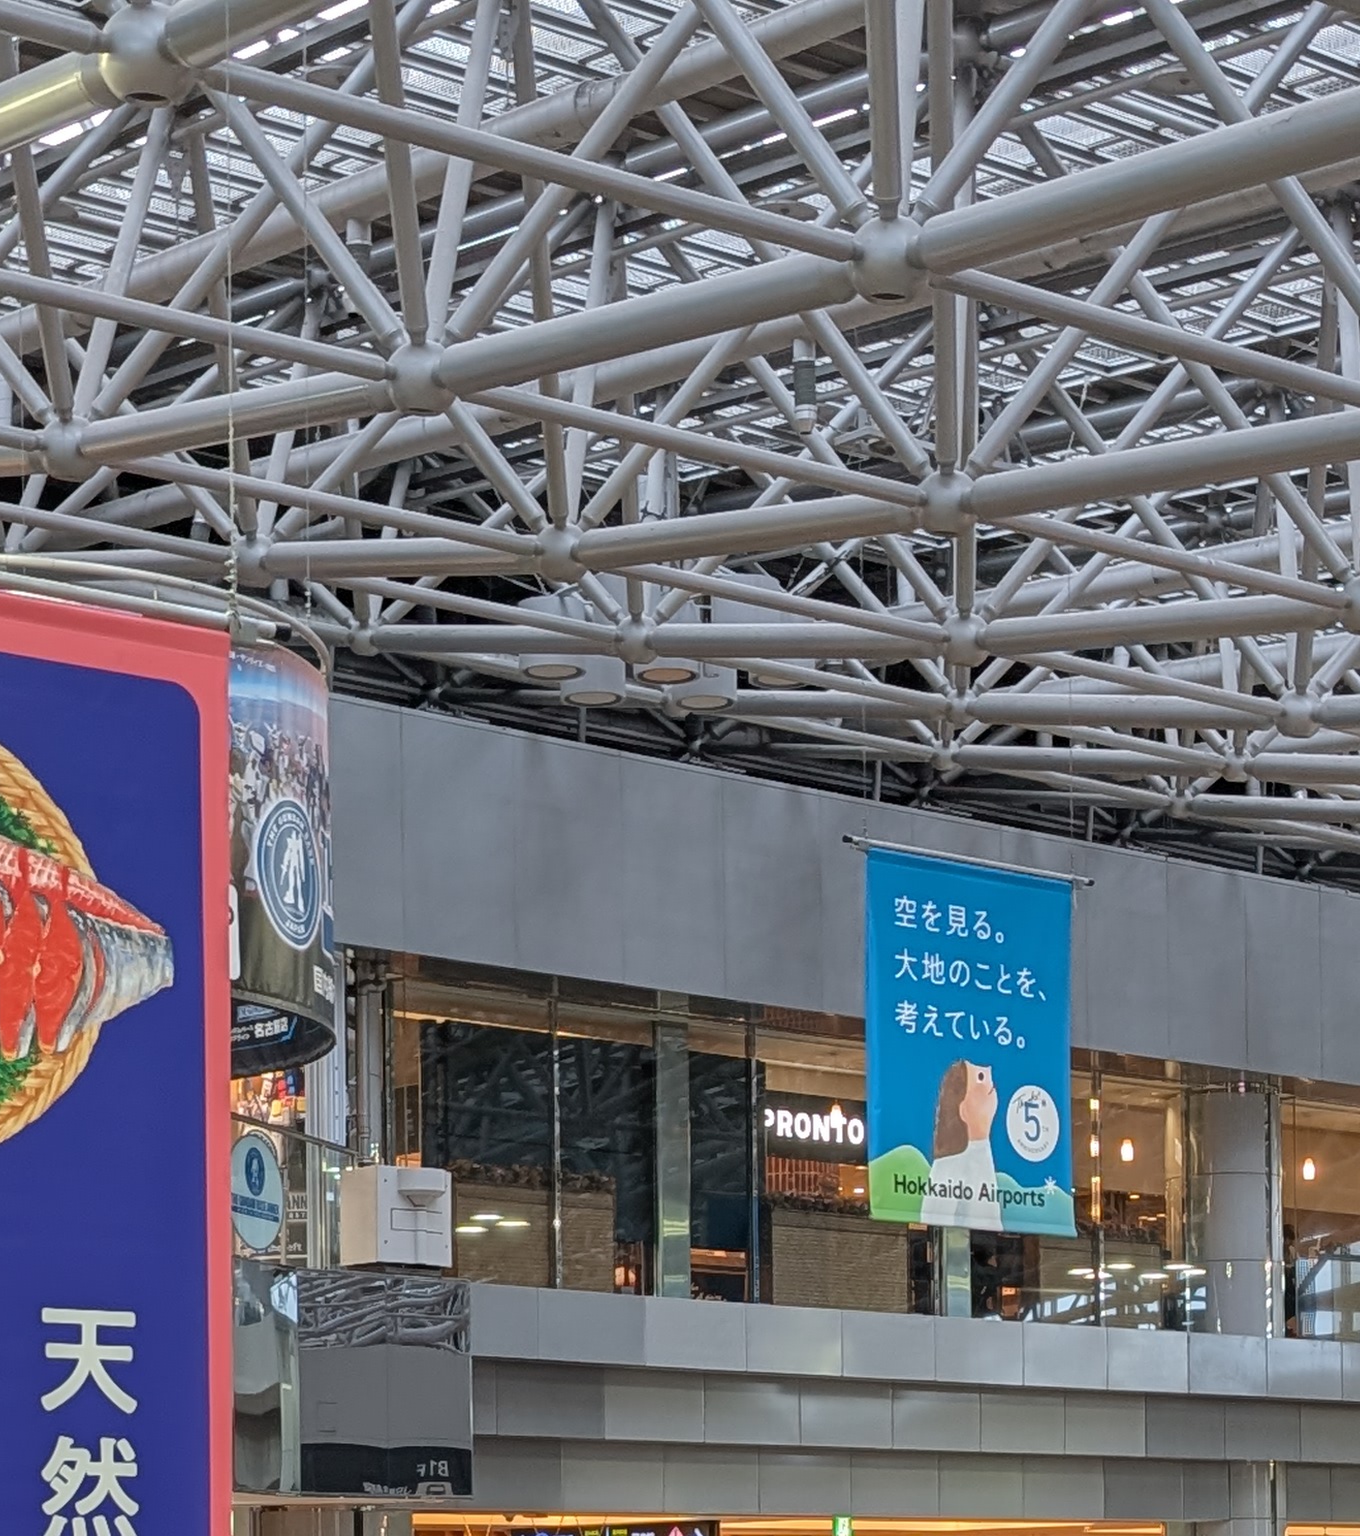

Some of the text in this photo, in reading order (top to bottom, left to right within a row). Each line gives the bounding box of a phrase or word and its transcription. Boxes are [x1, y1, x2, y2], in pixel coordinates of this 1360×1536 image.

[894, 895, 1005, 944] 空を見る。
[894, 949, 1047, 1002] 大地のことを、
[894, 1000, 1026, 1049] 考えている。
[764, 1107, 865, 1146] PRONTO
[893, 1173, 1046, 1208] Hokkaido Airports
